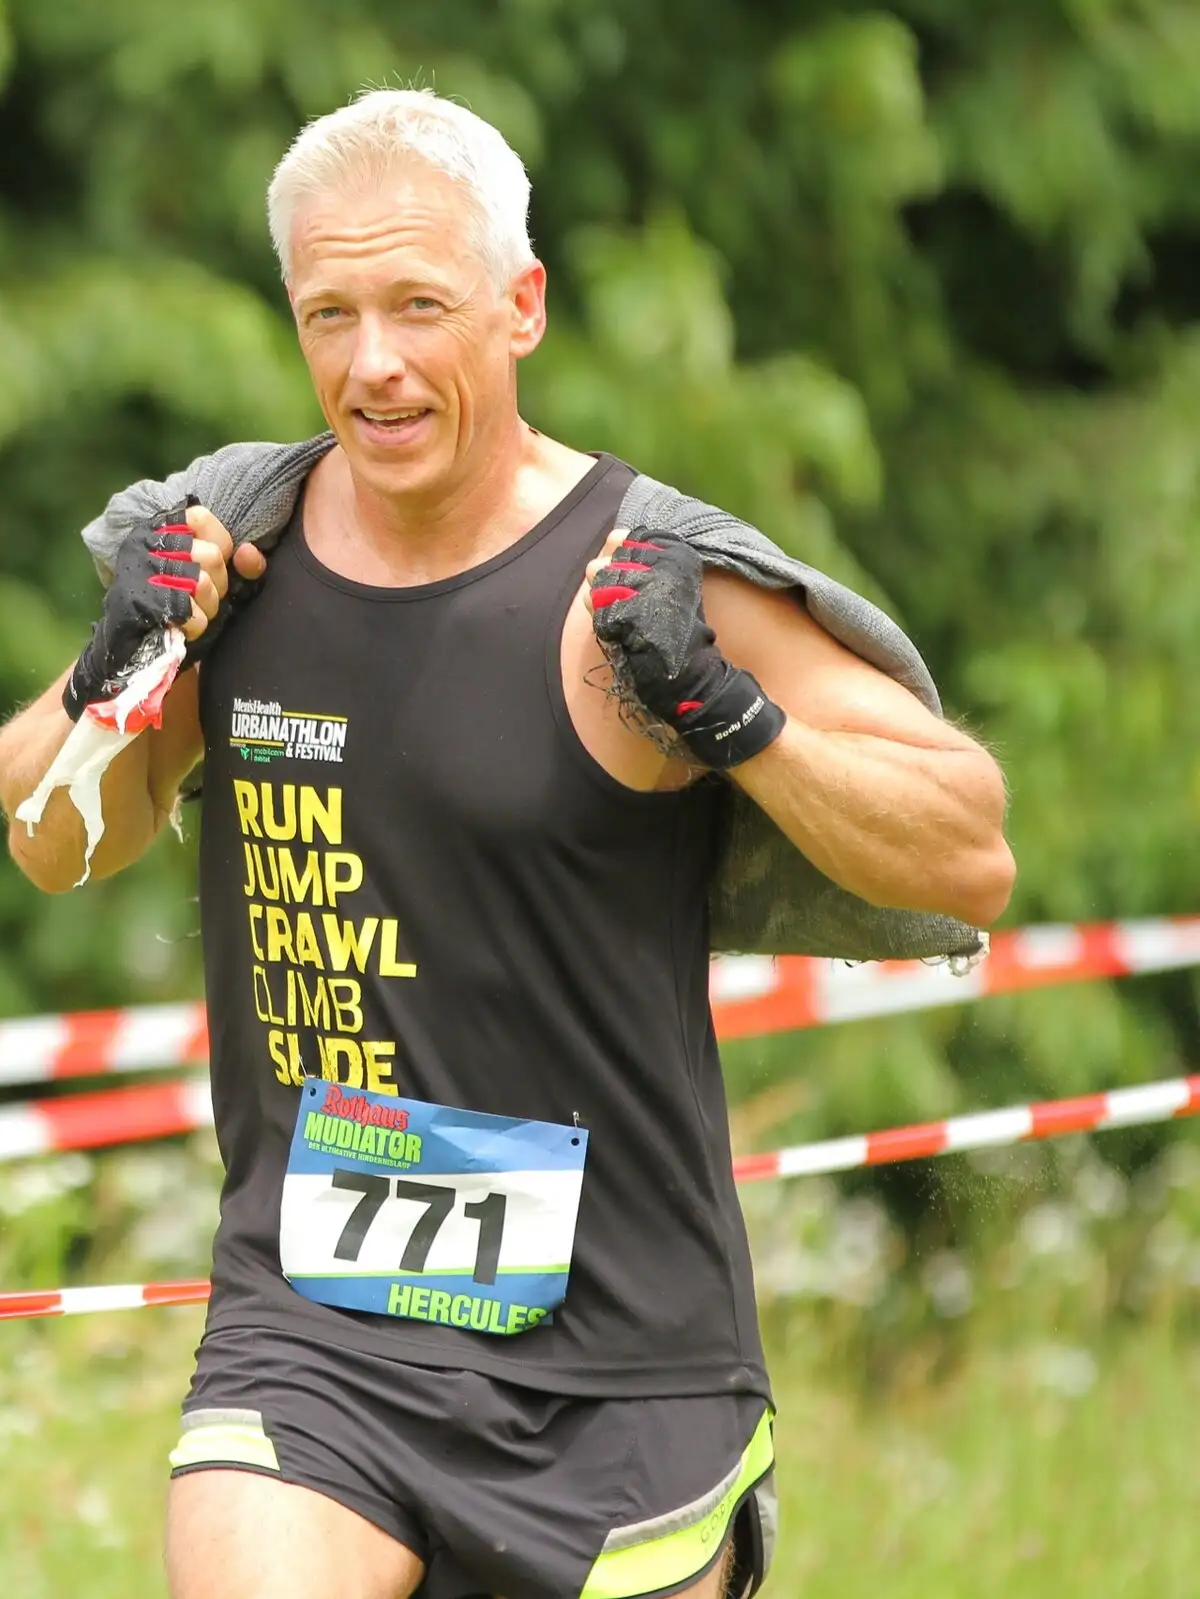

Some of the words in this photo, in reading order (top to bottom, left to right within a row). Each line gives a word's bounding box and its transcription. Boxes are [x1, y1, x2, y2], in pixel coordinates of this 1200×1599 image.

[231, 713, 347, 747] URBANATHLON
[285, 742, 294, 758] &
[295, 743, 344, 762] FESTIVAL
[233, 780, 342, 845] RUN
[243, 842, 363, 908] JUMP
[249, 904, 417, 978] CRAWL
[253, 965, 363, 1034] CLIMB
[304, 1111, 422, 1163] MUDIATOR
[321, 1084, 410, 1132] Rothaus
[308, 1141, 320, 1151] DER
[321, 1145, 357, 1160] ULTIMATIVE
[332, 1168, 508, 1286] 771
